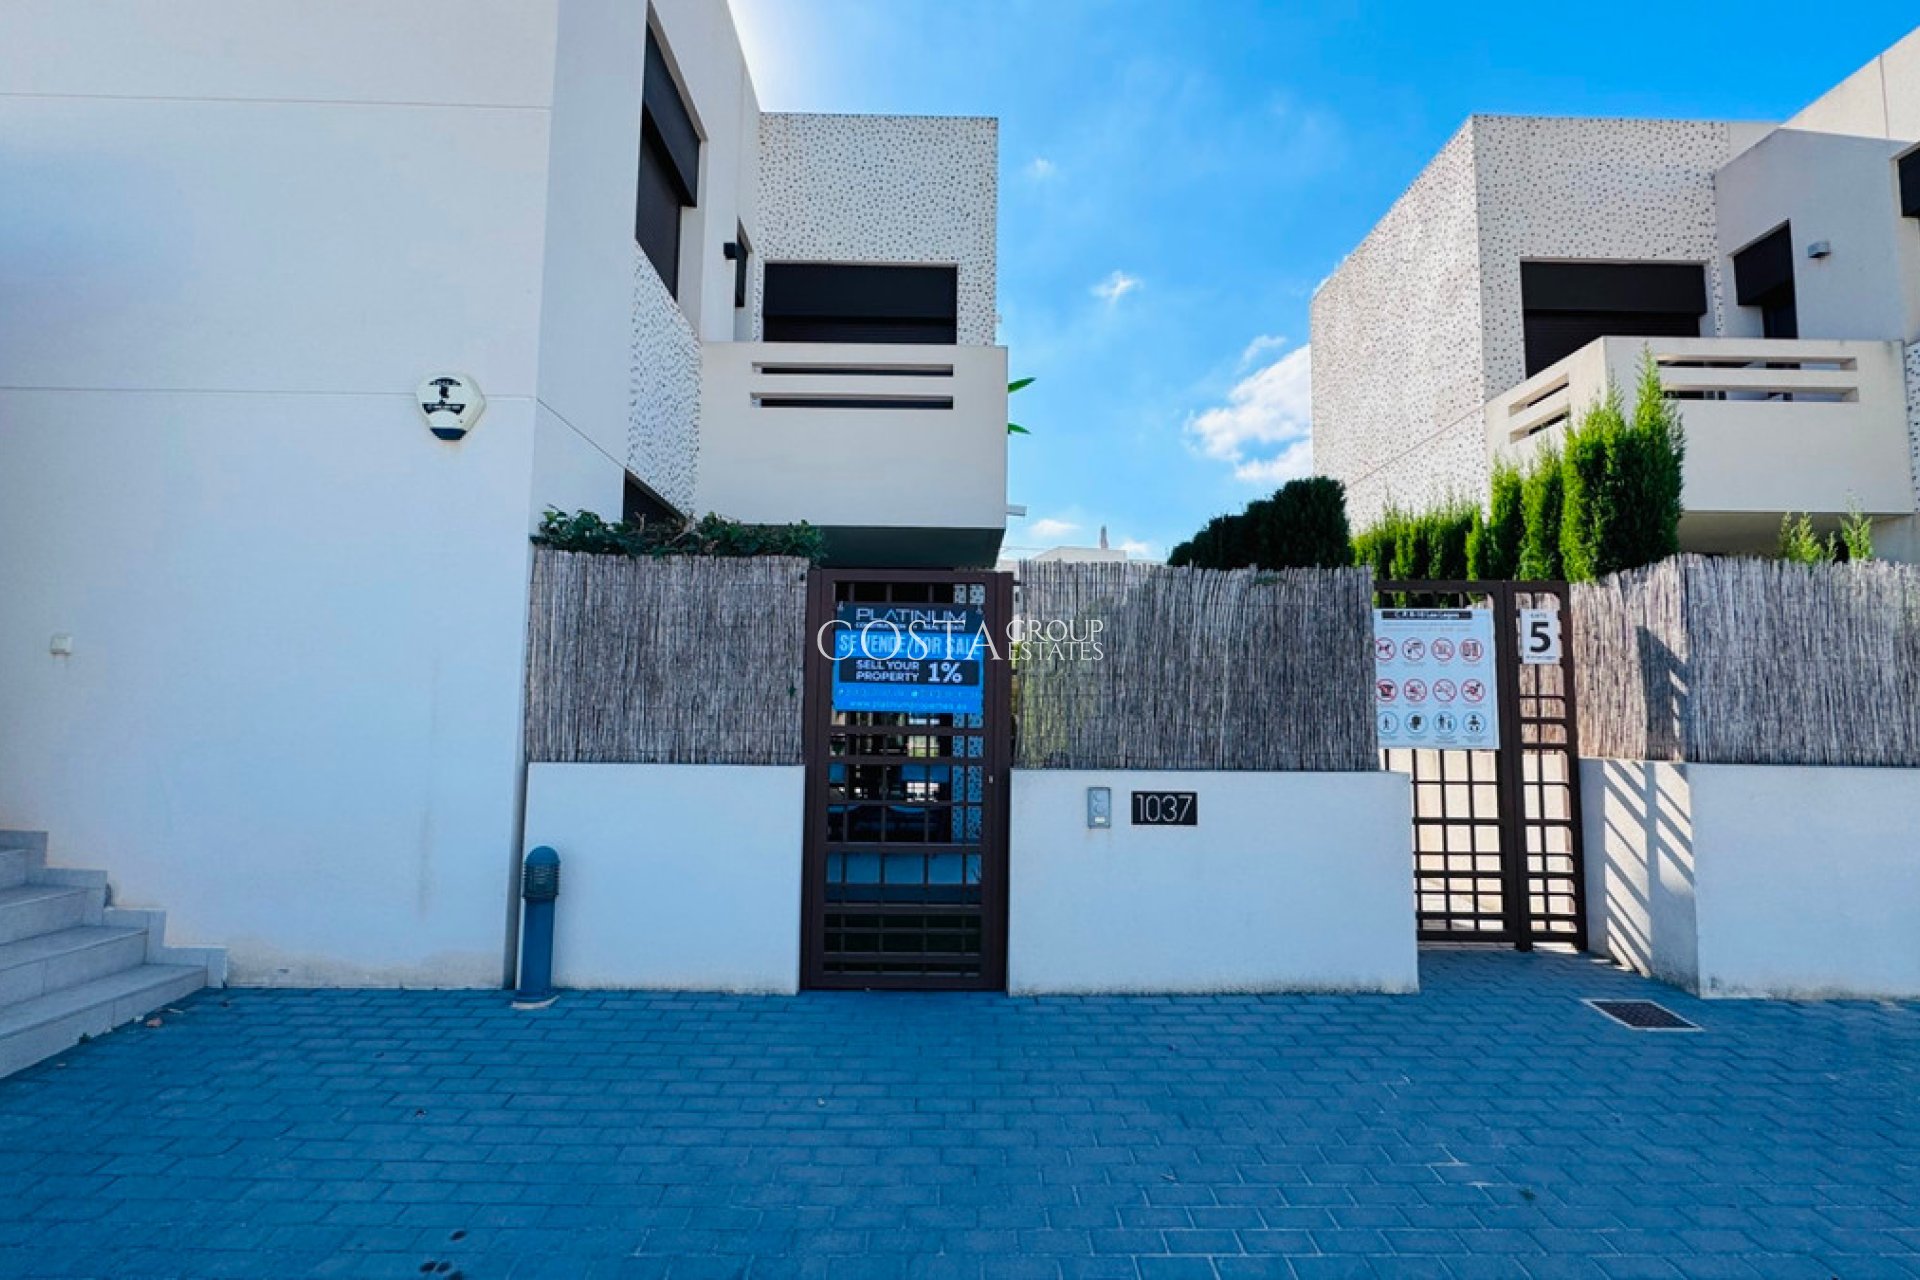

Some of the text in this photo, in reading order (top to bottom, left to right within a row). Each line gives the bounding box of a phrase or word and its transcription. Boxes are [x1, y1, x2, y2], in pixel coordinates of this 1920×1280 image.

[856, 608, 966, 621] PLATINUM
[839, 634, 857, 652] SE
[945, 636, 981, 655] SALE
[1529, 621, 1551, 653] 5
[856, 660, 919, 670] SELL YOUR
[928, 662, 963, 683] 1%
[856, 671, 920, 682] PROPERTY
[1136, 794, 1193, 822] 1037
